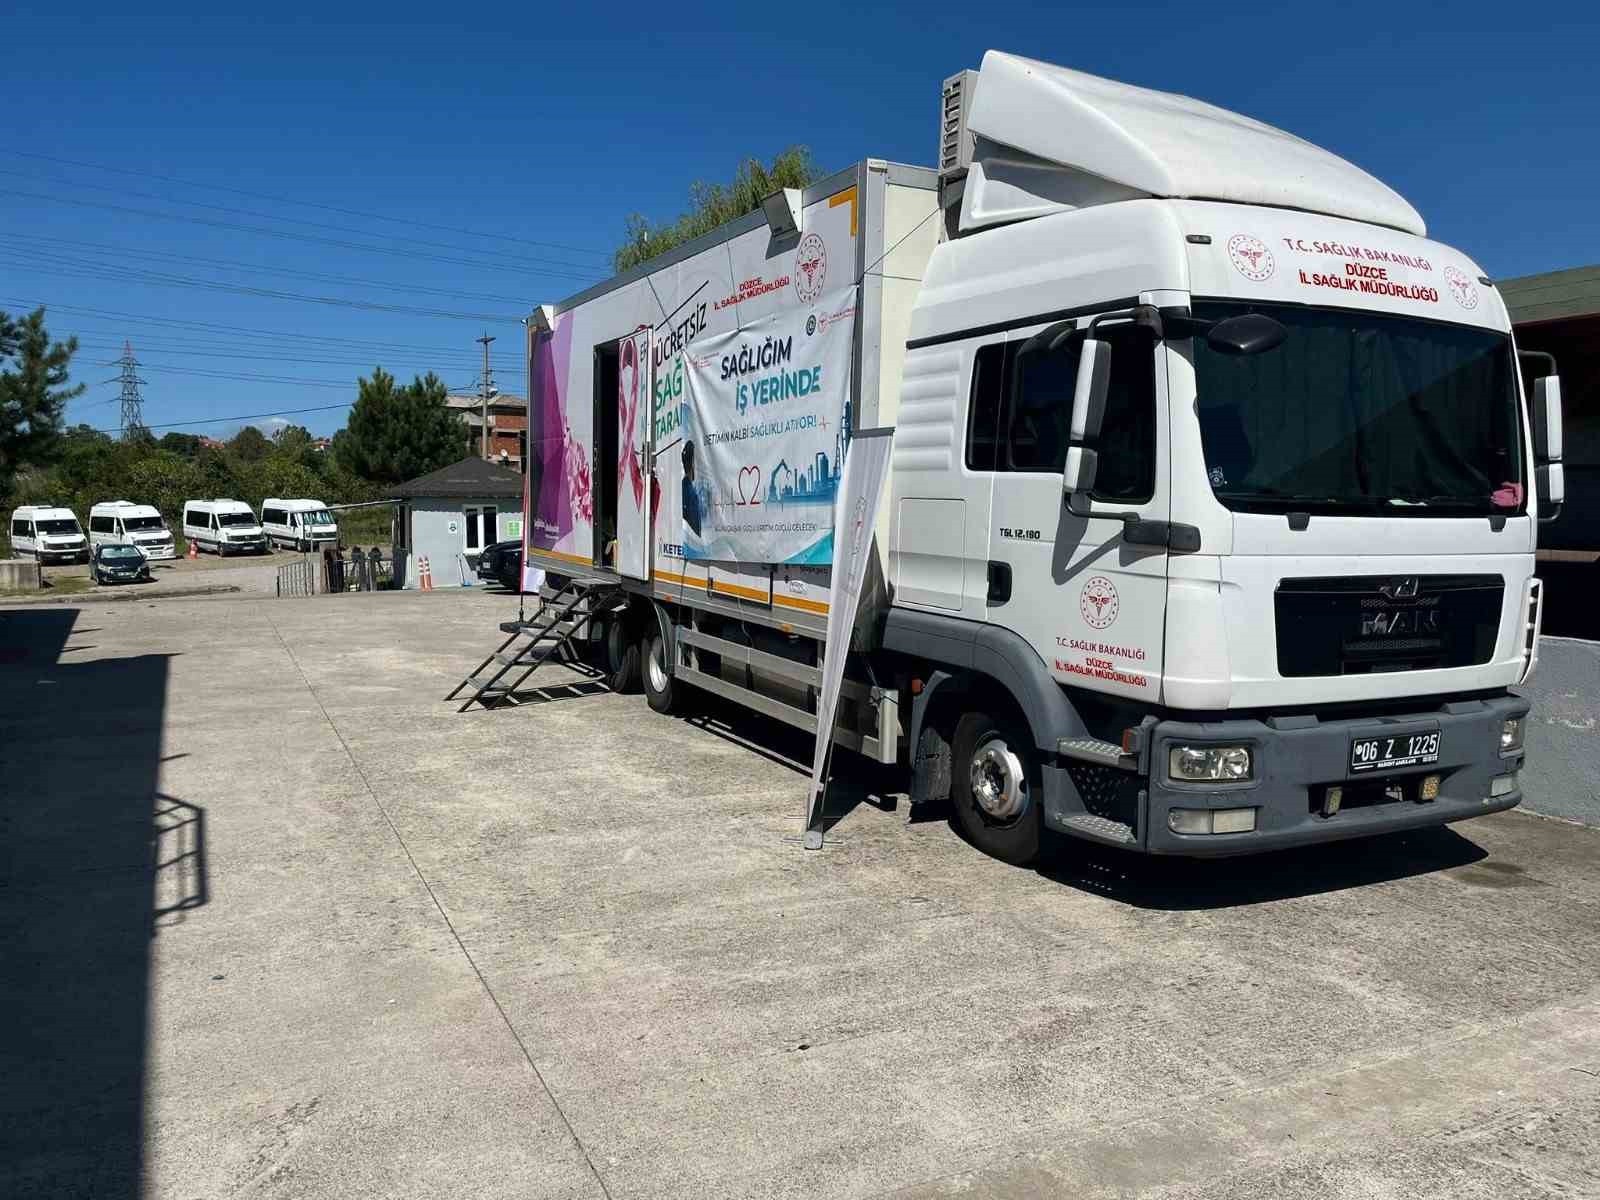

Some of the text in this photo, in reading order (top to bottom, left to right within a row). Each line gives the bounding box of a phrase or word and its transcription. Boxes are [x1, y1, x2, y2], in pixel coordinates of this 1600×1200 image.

[1283, 238, 1432, 271] T.C. SAĞLIK BAKANLIĞI
[1299, 268, 1439, 302] İL SAĞLIK MÜDÜRLÜĞÜ
[1345, 263, 1388, 281] DÜZCE
[656, 302, 707, 367] ÜCRETSİZ
[720, 336, 793, 380] SAĞLIĞIM
[735, 366, 822, 416] İŞ YERİNDE
[750, 421, 784, 438] SAĞLIKLI
[1055, 636, 1145, 660] T.C. SAĞLIK BAKANLIĞI
[1063, 662, 1094, 677] SAĞLIK
[1094, 667, 1147, 687] MÜDÜRLÜĞÜ
[1085, 657, 1113, 671] DÜZCE
[1362, 734, 1438, 761] 06 Z 1225
